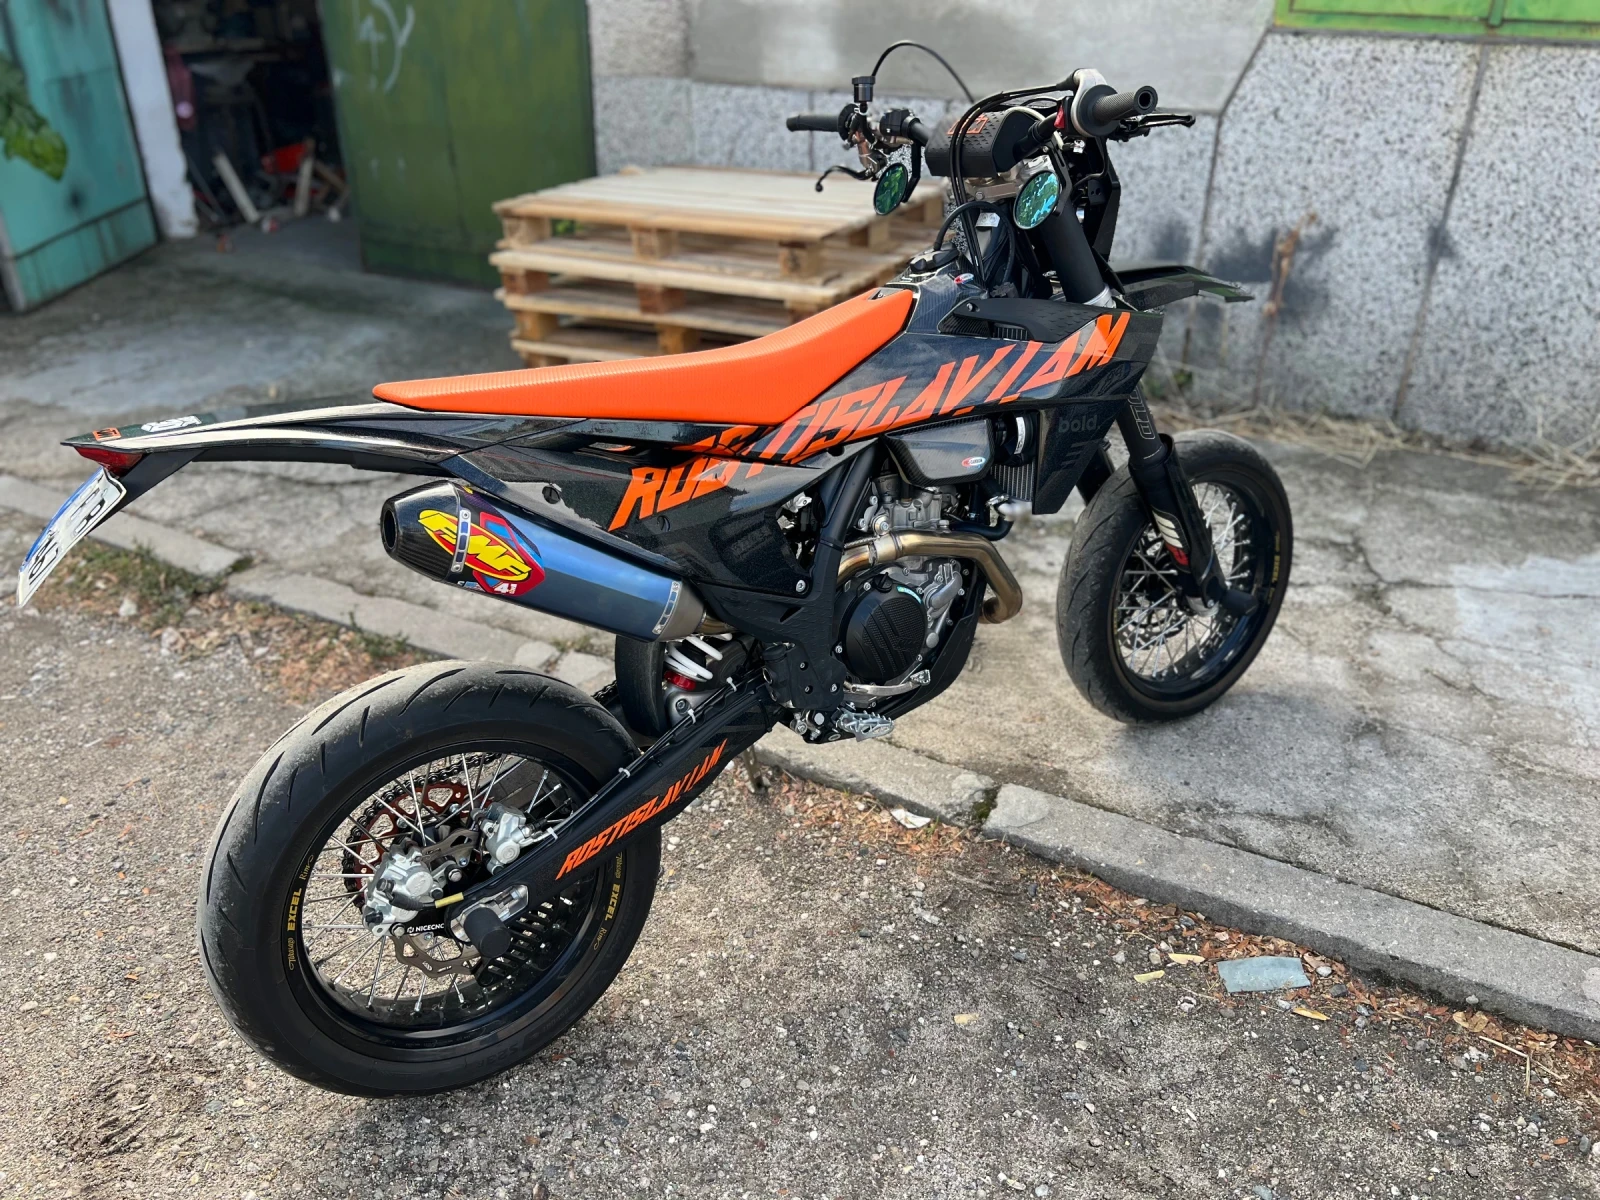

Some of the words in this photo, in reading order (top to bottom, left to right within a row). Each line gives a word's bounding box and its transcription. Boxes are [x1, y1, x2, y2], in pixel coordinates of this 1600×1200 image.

[1127, 385, 1156, 440] OLD
[418, 512, 533, 577] FMF
[287, 887, 303, 931] EXCEL
[299, 855, 314, 880] Rim
[604, 883, 621, 921] EXCEL
[415, 923, 445, 932] NICECNC
